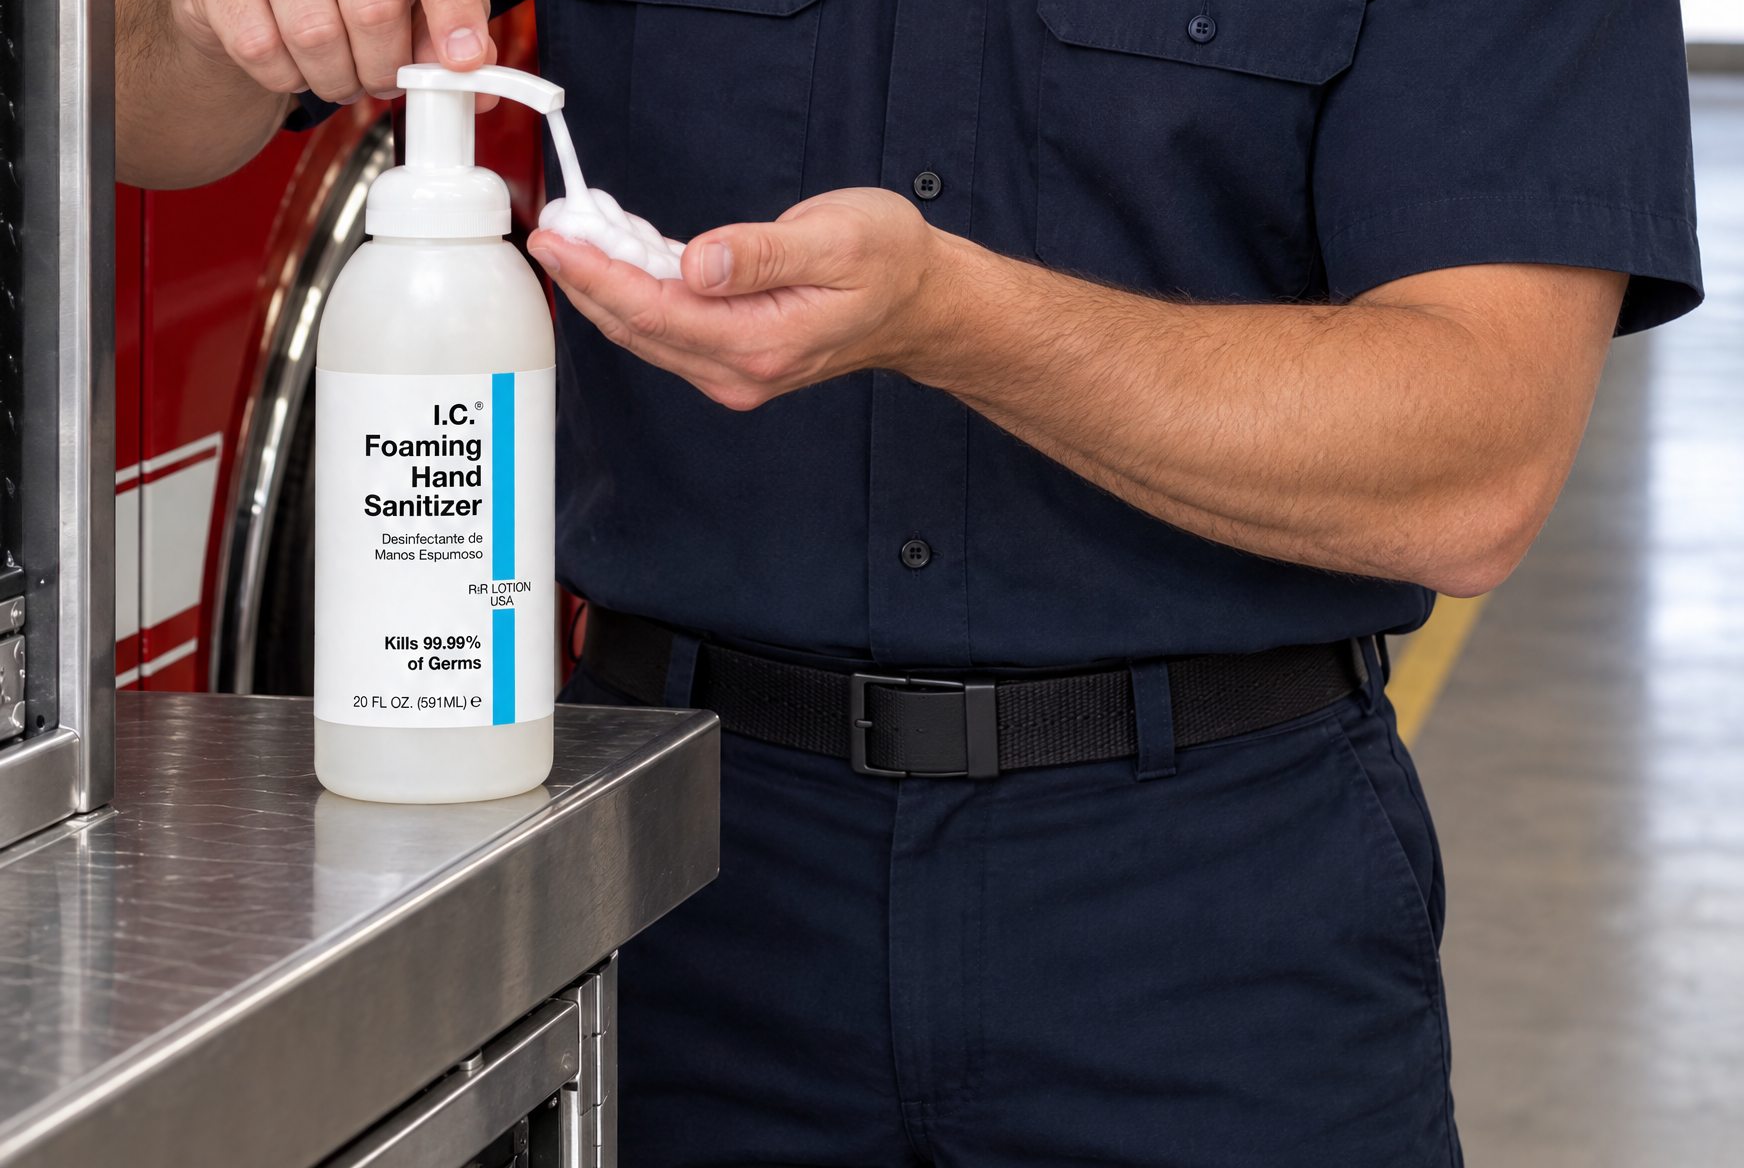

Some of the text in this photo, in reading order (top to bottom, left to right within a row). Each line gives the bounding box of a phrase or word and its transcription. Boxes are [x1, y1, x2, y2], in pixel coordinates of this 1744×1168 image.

[365, 434, 482, 461] Foaming
[412, 464, 482, 488] Hand
[364, 494, 483, 517] Sanitizer
[382, 532, 483, 545] Desinfectante de
[375, 549, 484, 563] Manos Espumoso
[491, 581, 531, 594] LOTION
[490, 595, 514, 607] USA
[384, 635, 482, 650] Kills 99.99%
[407, 656, 482, 671] of Germs
[353, 695, 368, 708] 20
[371, 696, 387, 709] FL
[390, 696, 413, 709] OZ.
[417, 695, 468, 711] (591ML)
